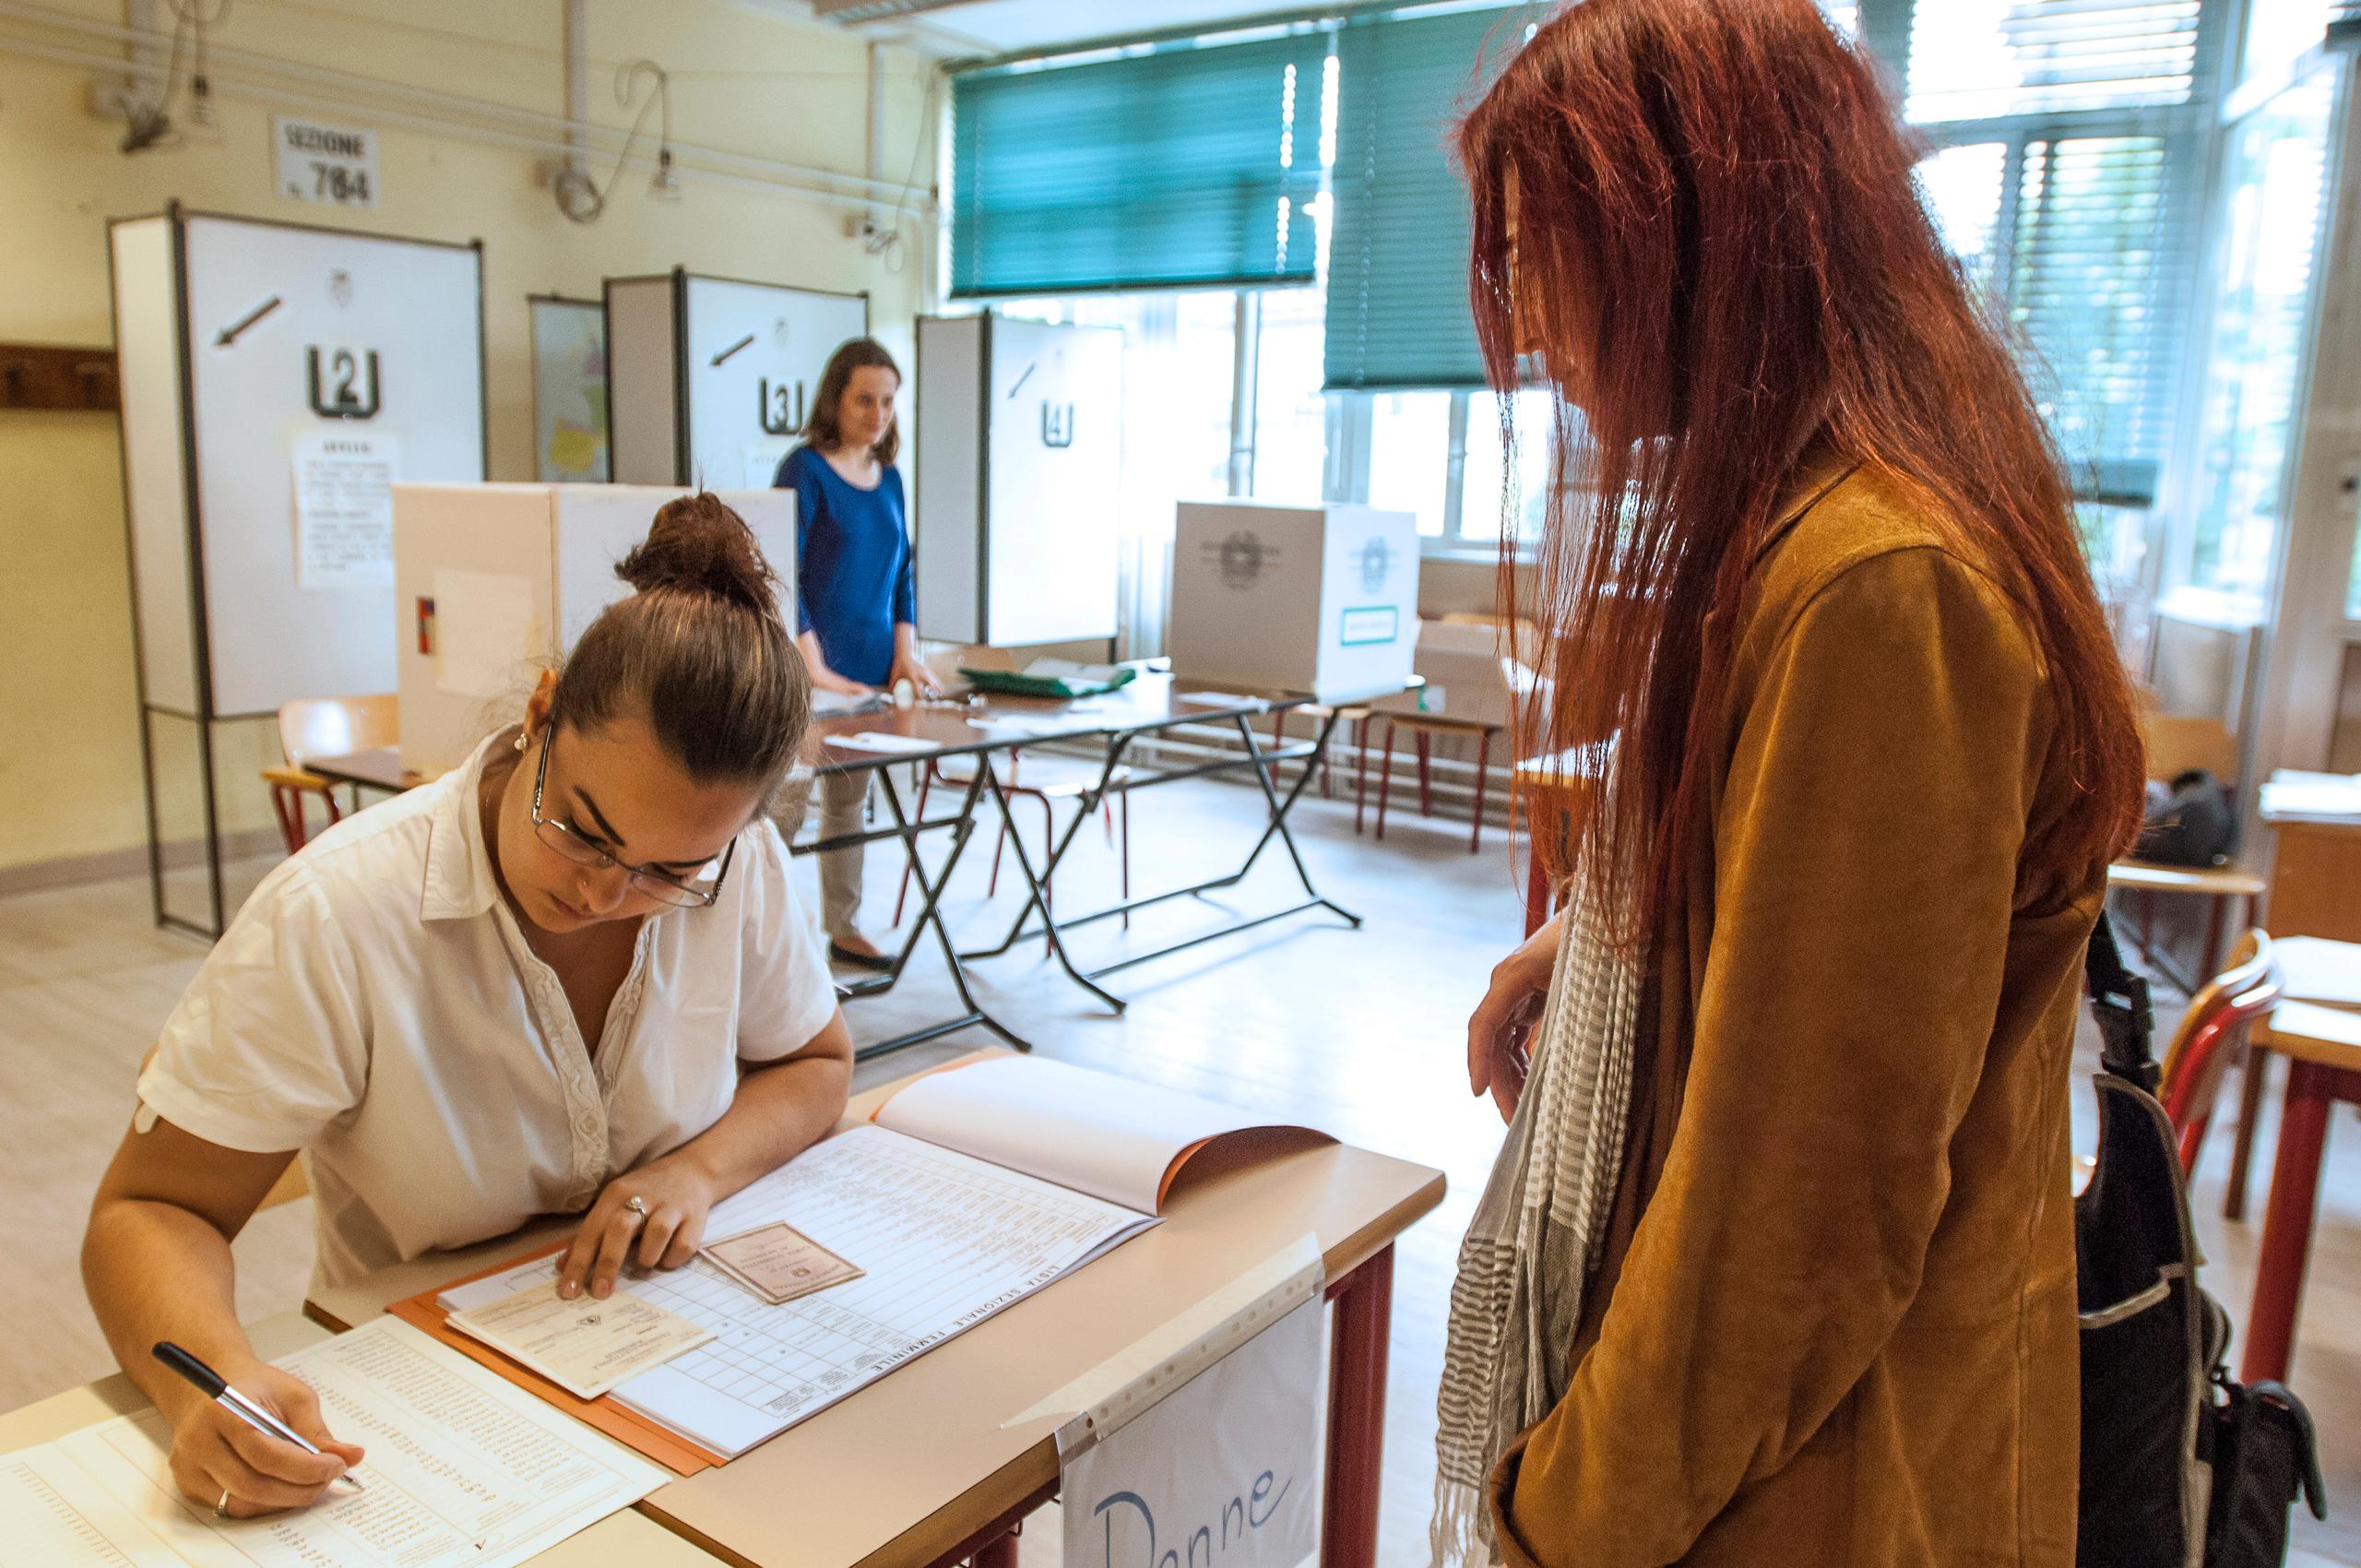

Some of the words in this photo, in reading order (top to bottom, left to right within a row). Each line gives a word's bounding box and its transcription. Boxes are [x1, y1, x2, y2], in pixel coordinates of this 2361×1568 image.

[283, 124, 365, 159] SEZIONE
[309, 160, 371, 201] 764
[1026, 1265, 1061, 1288] LISTA
[952, 1288, 1023, 1328] SEZIONALE
[869, 1330, 946, 1372] FEMMINILE
